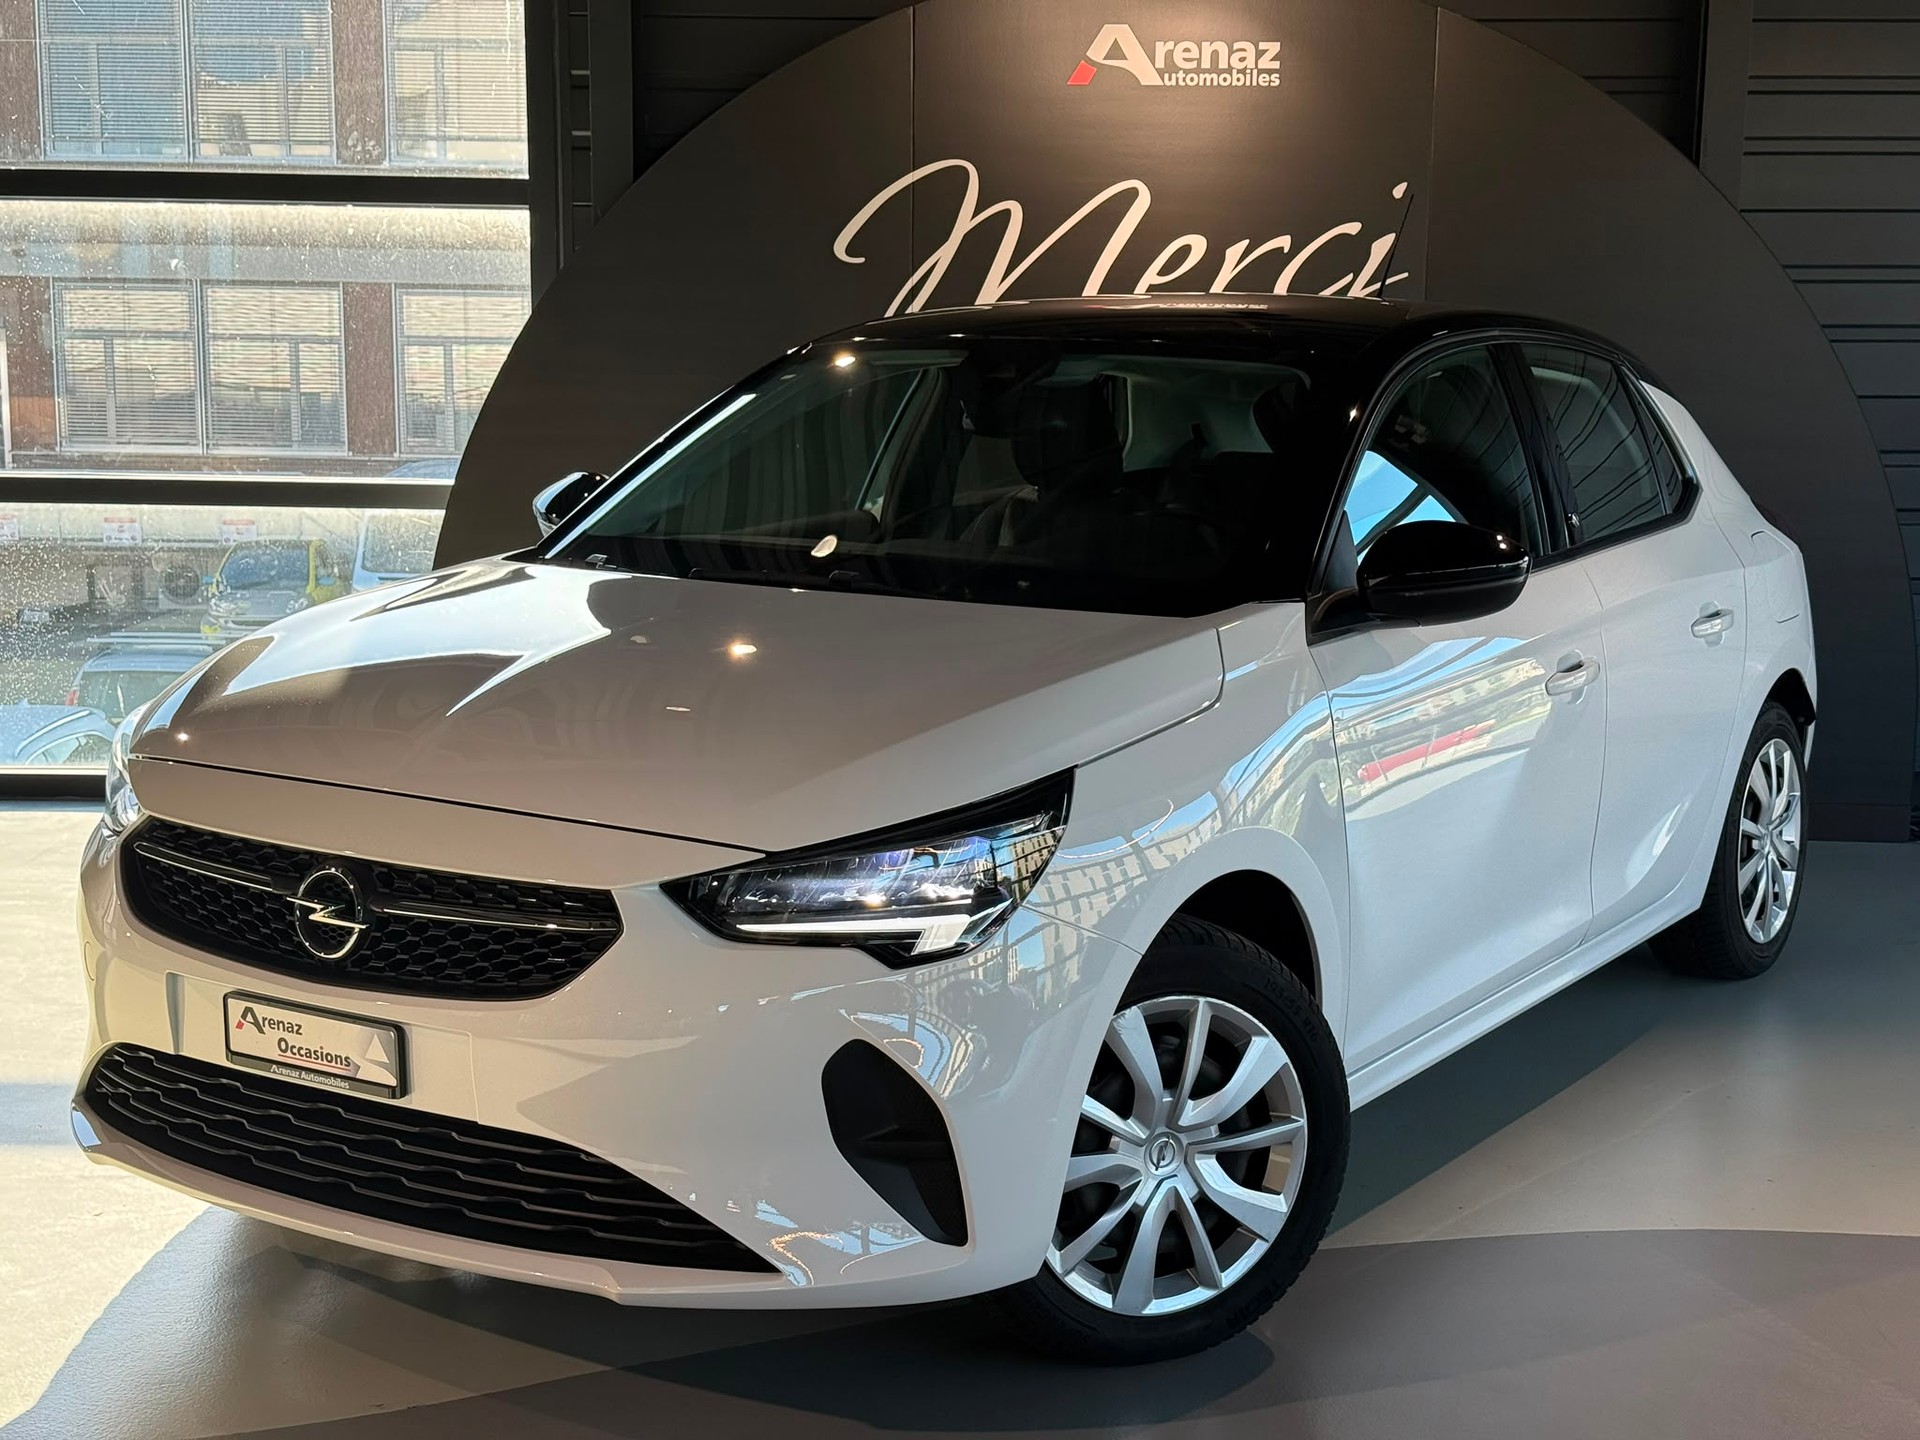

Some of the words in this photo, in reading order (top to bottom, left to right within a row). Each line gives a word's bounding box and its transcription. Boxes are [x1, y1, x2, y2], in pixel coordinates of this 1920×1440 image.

[1068, 24, 1281, 86] Arenaz
[834, 158, 1410, 317] Merci
[235, 1005, 303, 1036] Arenaz
[277, 1037, 352, 1068] Occasions
[270, 1064, 300, 1079] Arenaz
[301, 1070, 350, 1090] Automobiles
